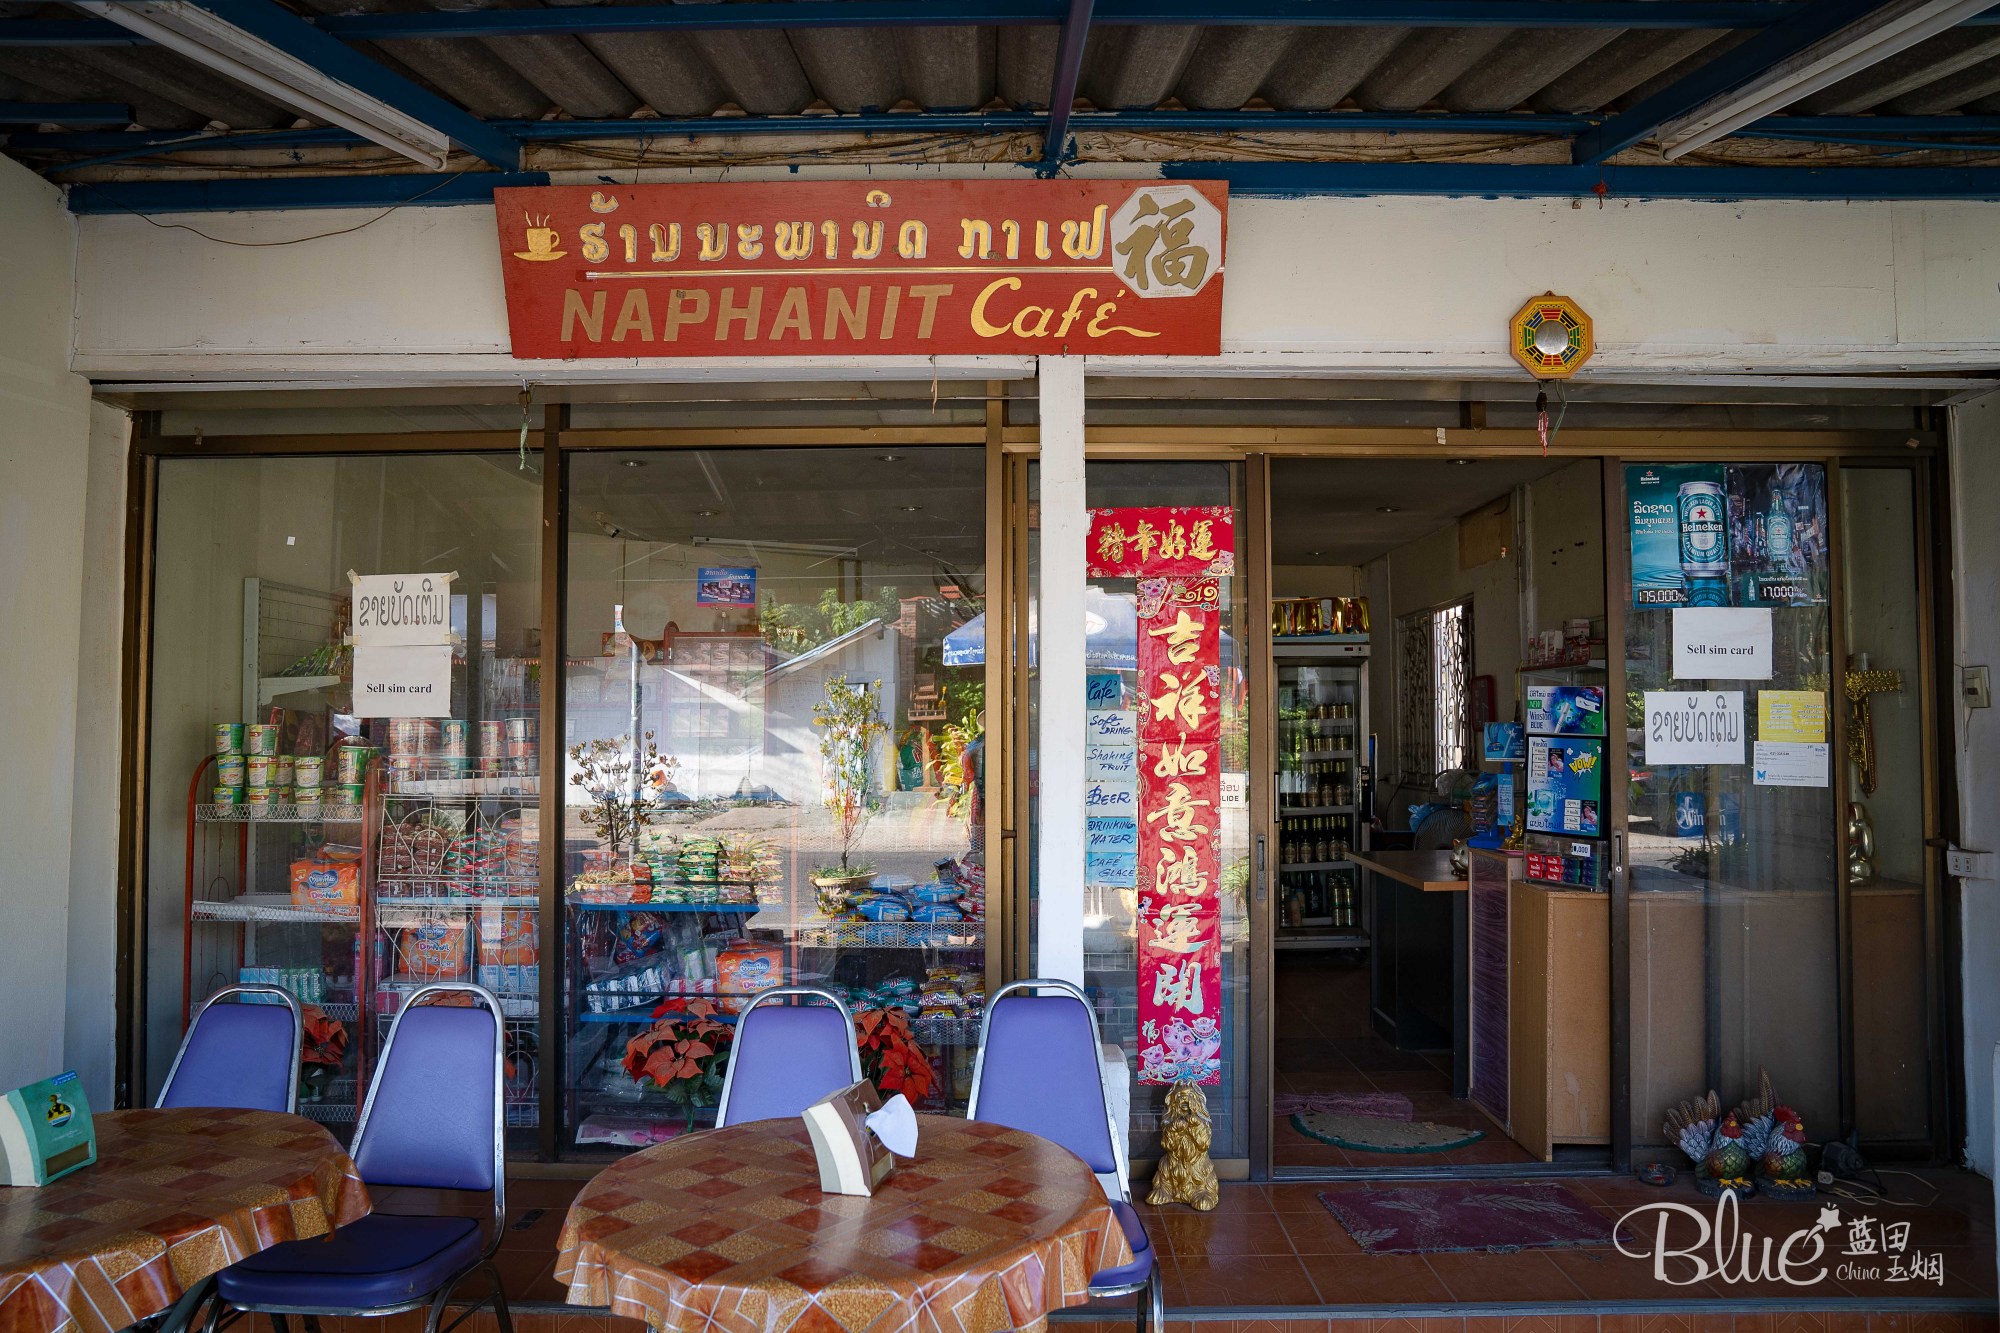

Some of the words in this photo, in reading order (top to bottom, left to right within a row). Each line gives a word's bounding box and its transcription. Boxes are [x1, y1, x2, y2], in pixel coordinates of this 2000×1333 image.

[1115, 193, 1209, 290] 福
[560, 284, 954, 343] NAPHANIT
[970, 276, 1162, 338] Café
[1682, 522, 1724, 533] Heineken
[1687, 644, 1706, 655] Sell
[1708, 644, 1727, 655] sim
[1730, 645, 1754, 656] card
[366, 683, 385, 694] Sell
[388, 683, 406, 694] sim
[408, 683, 432, 694] card
[1529, 700, 1541, 708] NEW
[1529, 711, 1552, 721] Winston
[1530, 721, 1543, 729] BLUE
[1100, 763, 1130, 772] FRUIT
[1568, 756, 1597, 773] WOW!
[1090, 833, 1133, 845] WATER
